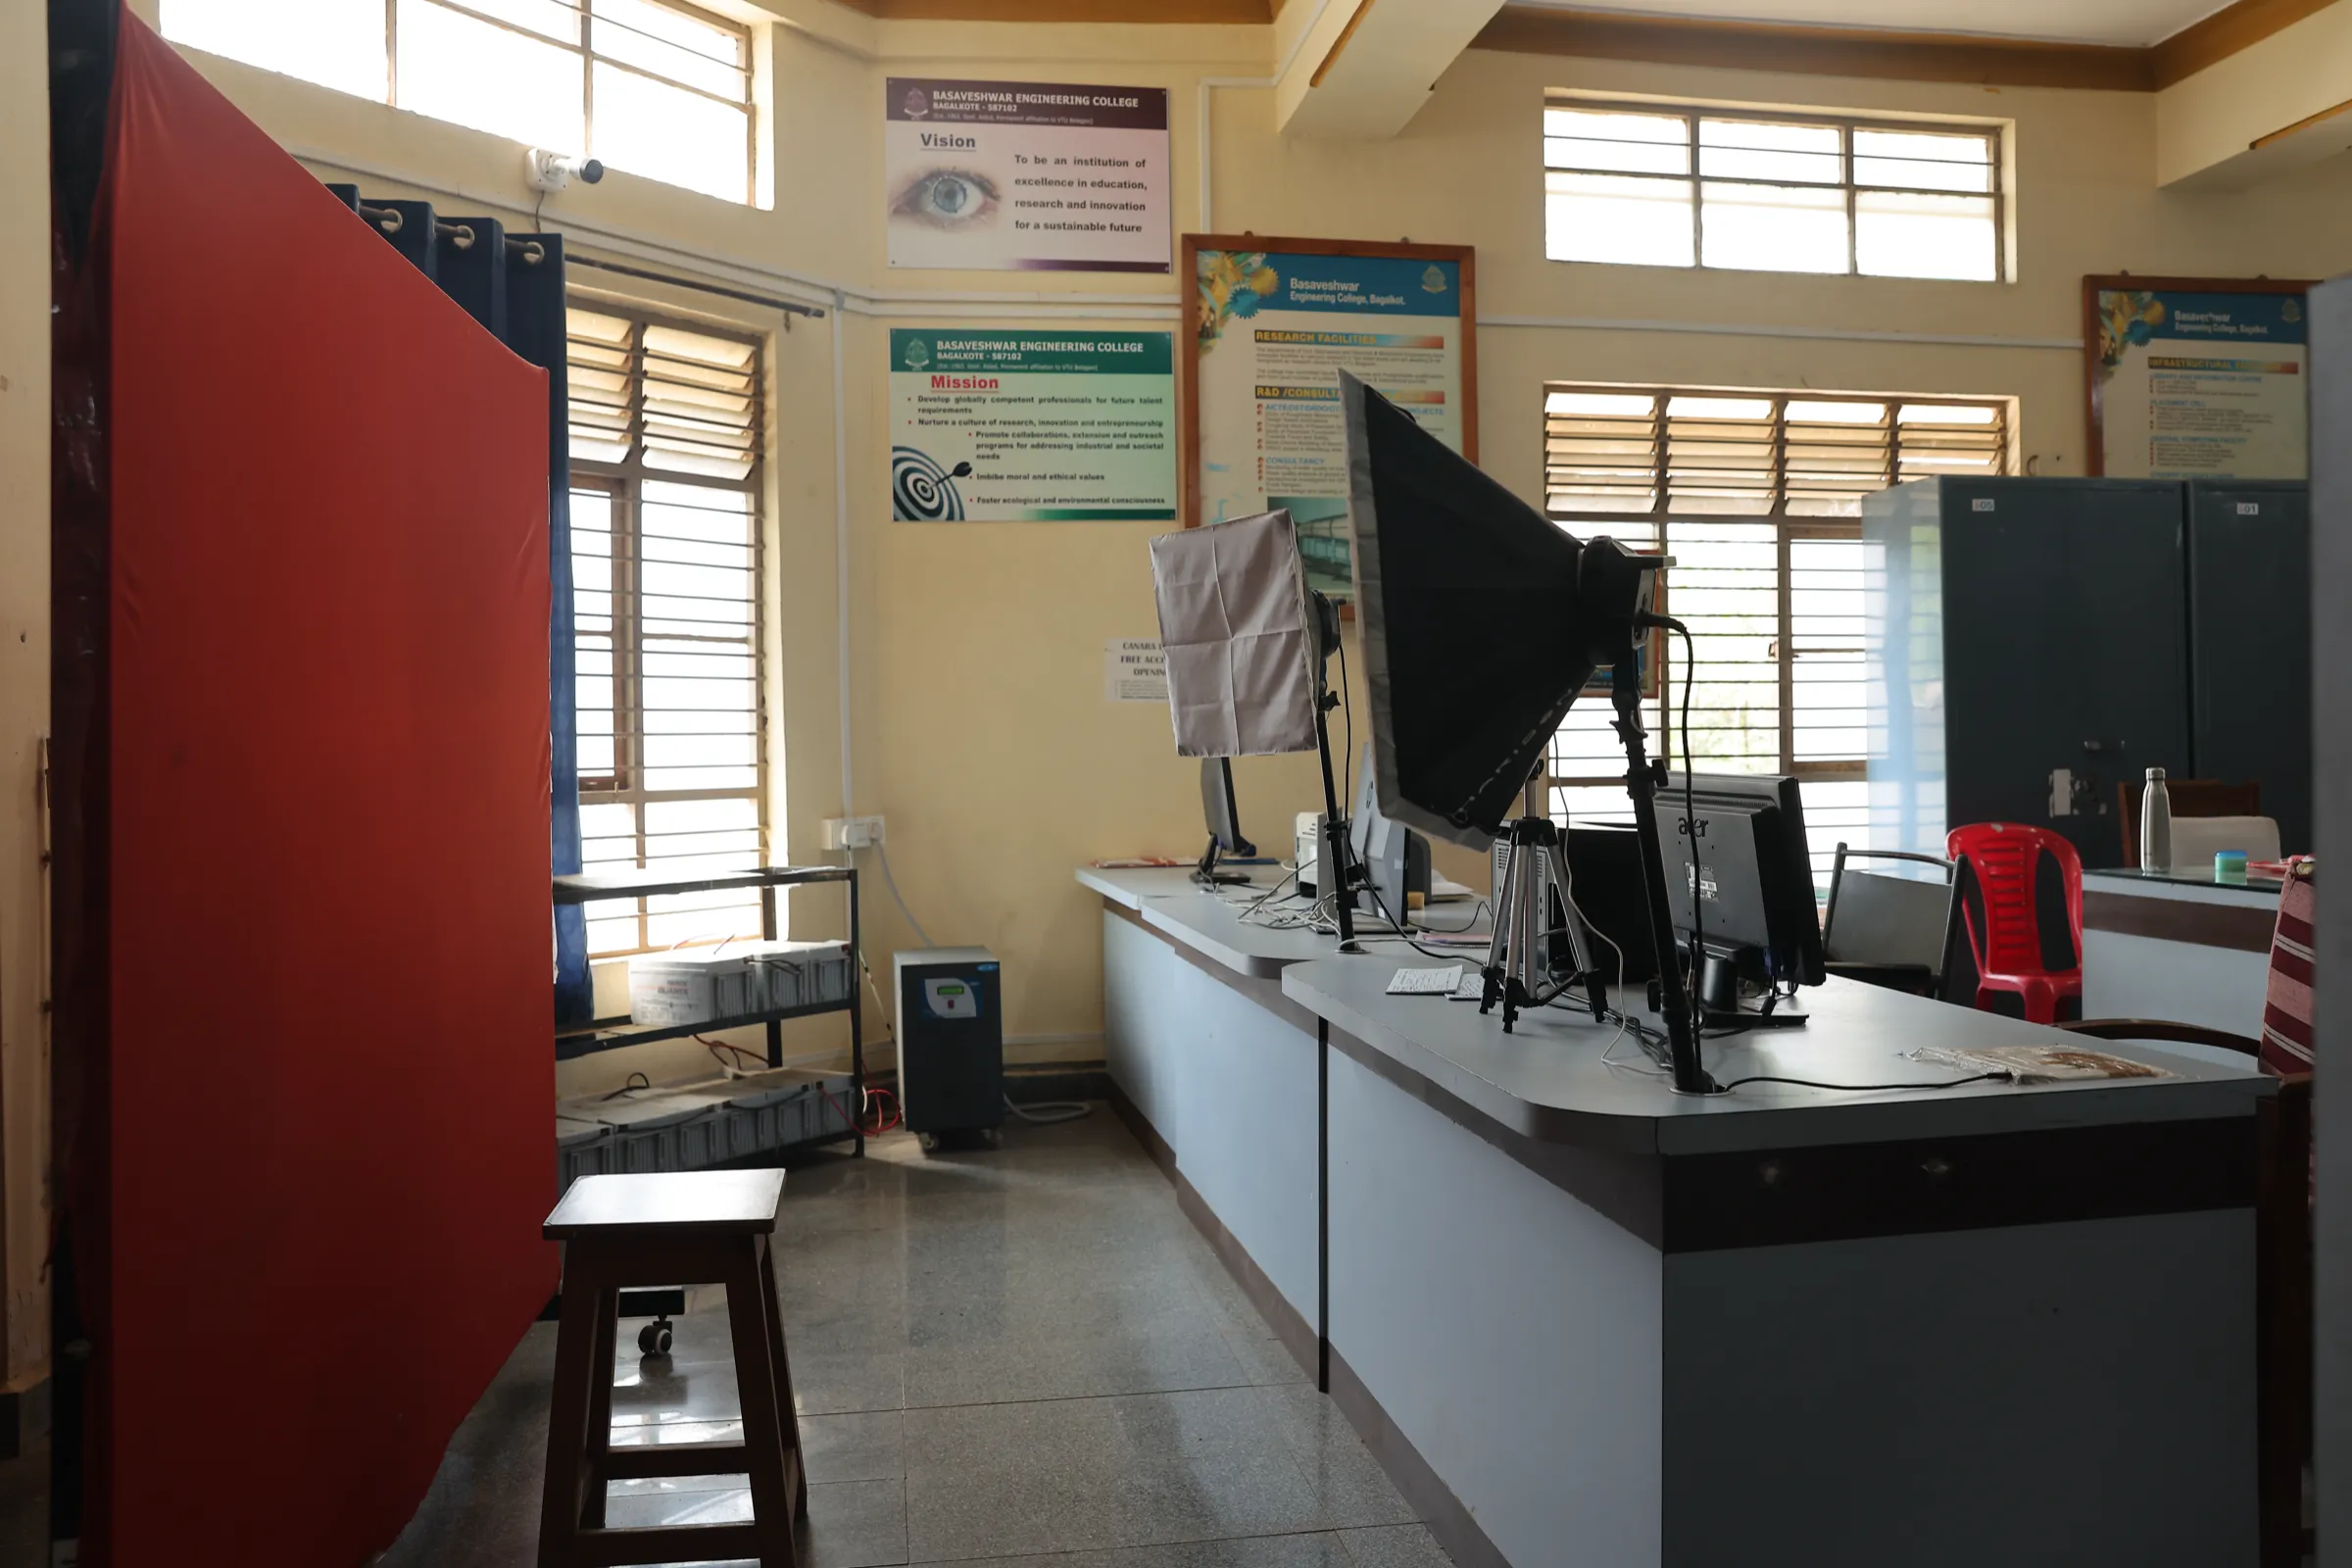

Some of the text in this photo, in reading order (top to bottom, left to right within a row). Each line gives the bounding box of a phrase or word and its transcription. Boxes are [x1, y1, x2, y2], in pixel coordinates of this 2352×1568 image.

[933, 90, 1139, 108] BASAVESHWAR ENGINEERING COLLEGE
[933, 101, 981, 112] BAGALKOTE
[987, 103, 1018, 113] 587102
[920, 133, 976, 148] Vision
[1014, 155, 1028, 165] To
[1034, 155, 1048, 165] be
[1073, 157, 1129, 168] institution
[1135, 159, 1146, 169] of
[1014, 176, 1148, 191] excellence in education,
[1014, 199, 1146, 211] research and innovation
[1014, 220, 1030, 229] for
[1044, 221, 1106, 231] sustainable
[1109, 223, 1143, 232] future
[1290, 277, 1360, 292] Basaveshwar
[1290, 292, 1336, 304] Engineering
[1337, 292, 1369, 306] College,
[1256, 331, 1376, 345] RESEARCH FACILITIES
[937, 341, 1144, 353] BASAVESHWAR ENGINEERING COLLEGE
[992, 352, 1022, 361] 587102
[931, 375, 999, 389] Mission
[1256, 387, 1341, 399] R&D /CONSULT
[1122, 642, 1156, 651] CANARA
[1678, 817, 1709, 837] aer
